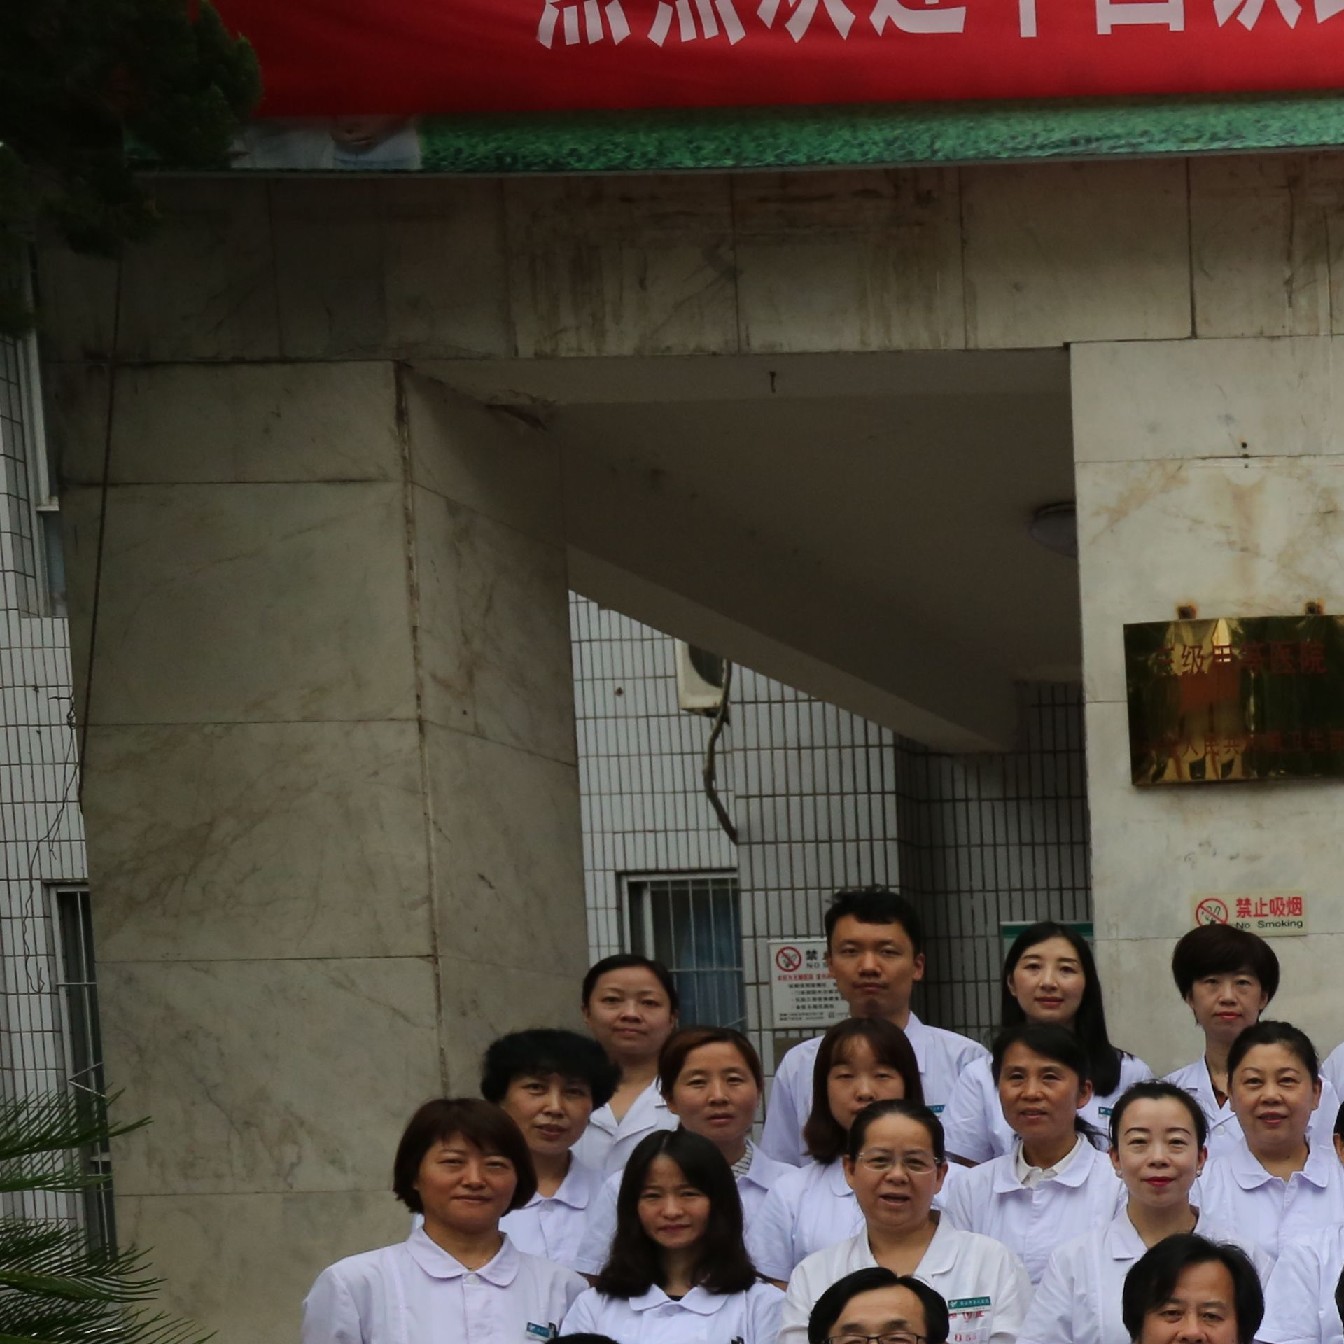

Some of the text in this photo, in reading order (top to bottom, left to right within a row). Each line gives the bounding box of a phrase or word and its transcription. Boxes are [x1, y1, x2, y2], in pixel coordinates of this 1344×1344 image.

[1235, 896, 1303, 918] 禁止吸烟
[1257, 919, 1304, 929] Smoking
